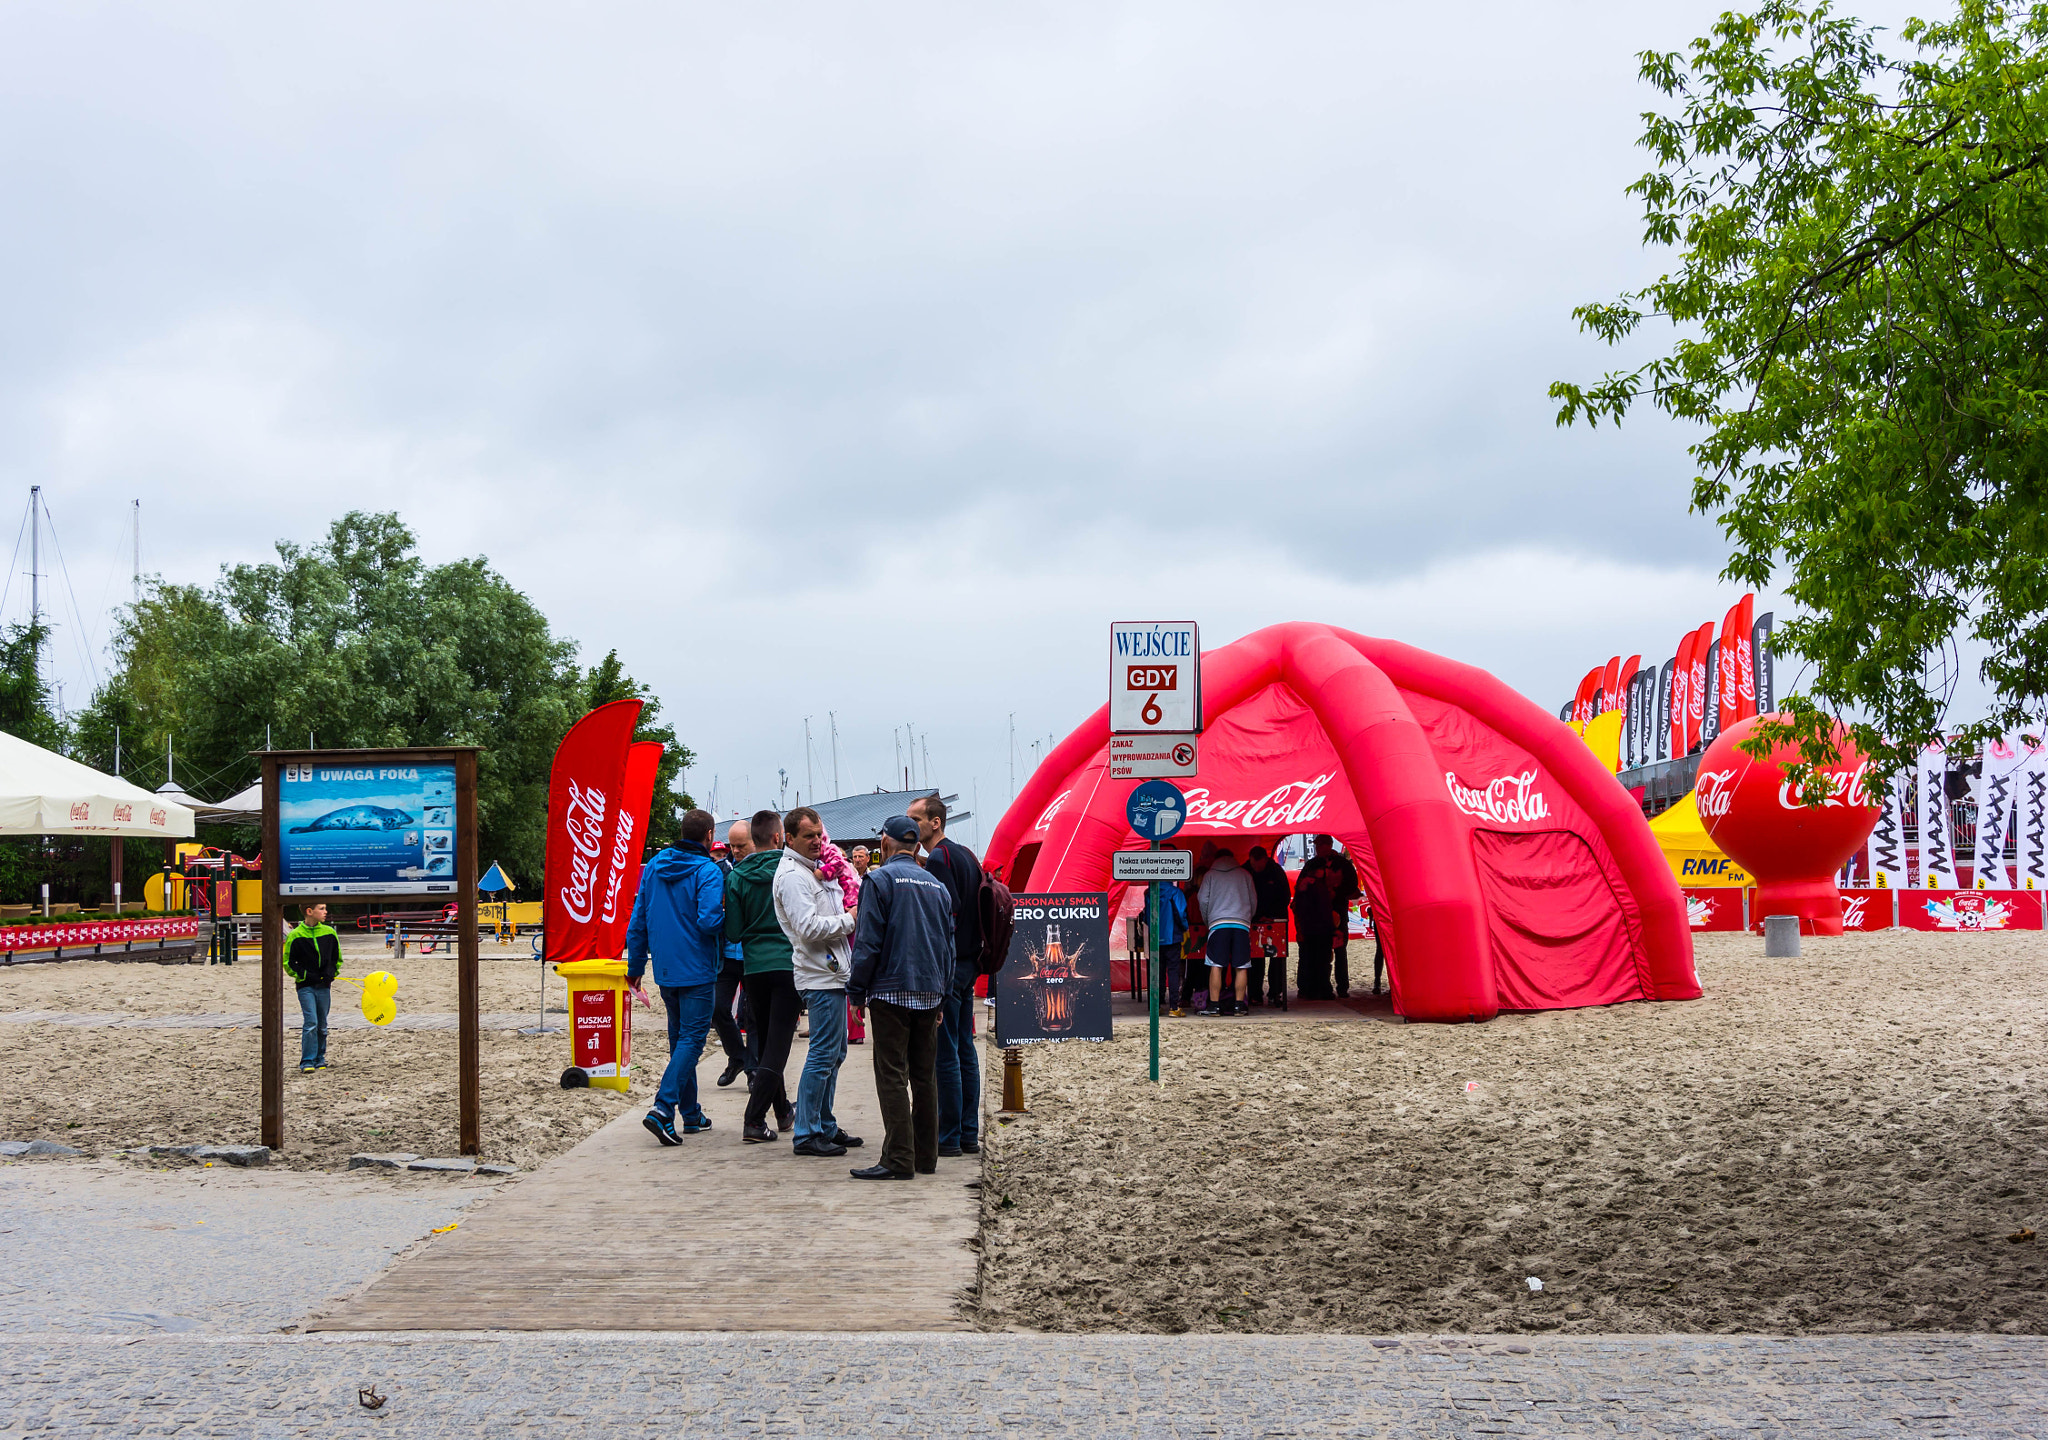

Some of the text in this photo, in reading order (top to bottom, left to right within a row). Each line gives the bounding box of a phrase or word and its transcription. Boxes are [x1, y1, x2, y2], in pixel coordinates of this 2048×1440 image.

[1116, 625, 1190, 656] WEJŚCIE
[1129, 669, 1175, 687] GDY
[1141, 693, 1163, 725] 6
[1112, 740, 1134, 748] ZAKAZ
[1112, 752, 1171, 762] WYPROWADZANIA
[320, 769, 419, 781] UWAGA FOKA
[1112, 767, 1132, 775] PSÓW
[1445, 768, 1551, 823] Coca-Cola
[561, 768, 606, 924] Coca-Cola
[1119, 856, 1185, 866] Nakaz ustawicznego
[1119, 866, 1185, 875] nadzoru nad dziećmi
[1682, 858, 1744, 881] RMF FM
[1013, 897, 1099, 907] OSKONAŁY SMAK
[1013, 907, 1100, 920] ERO CUKRU
[1040, 967, 1069, 978] Coca-Cola
[577, 1016, 612, 1025] PUSZKA?
